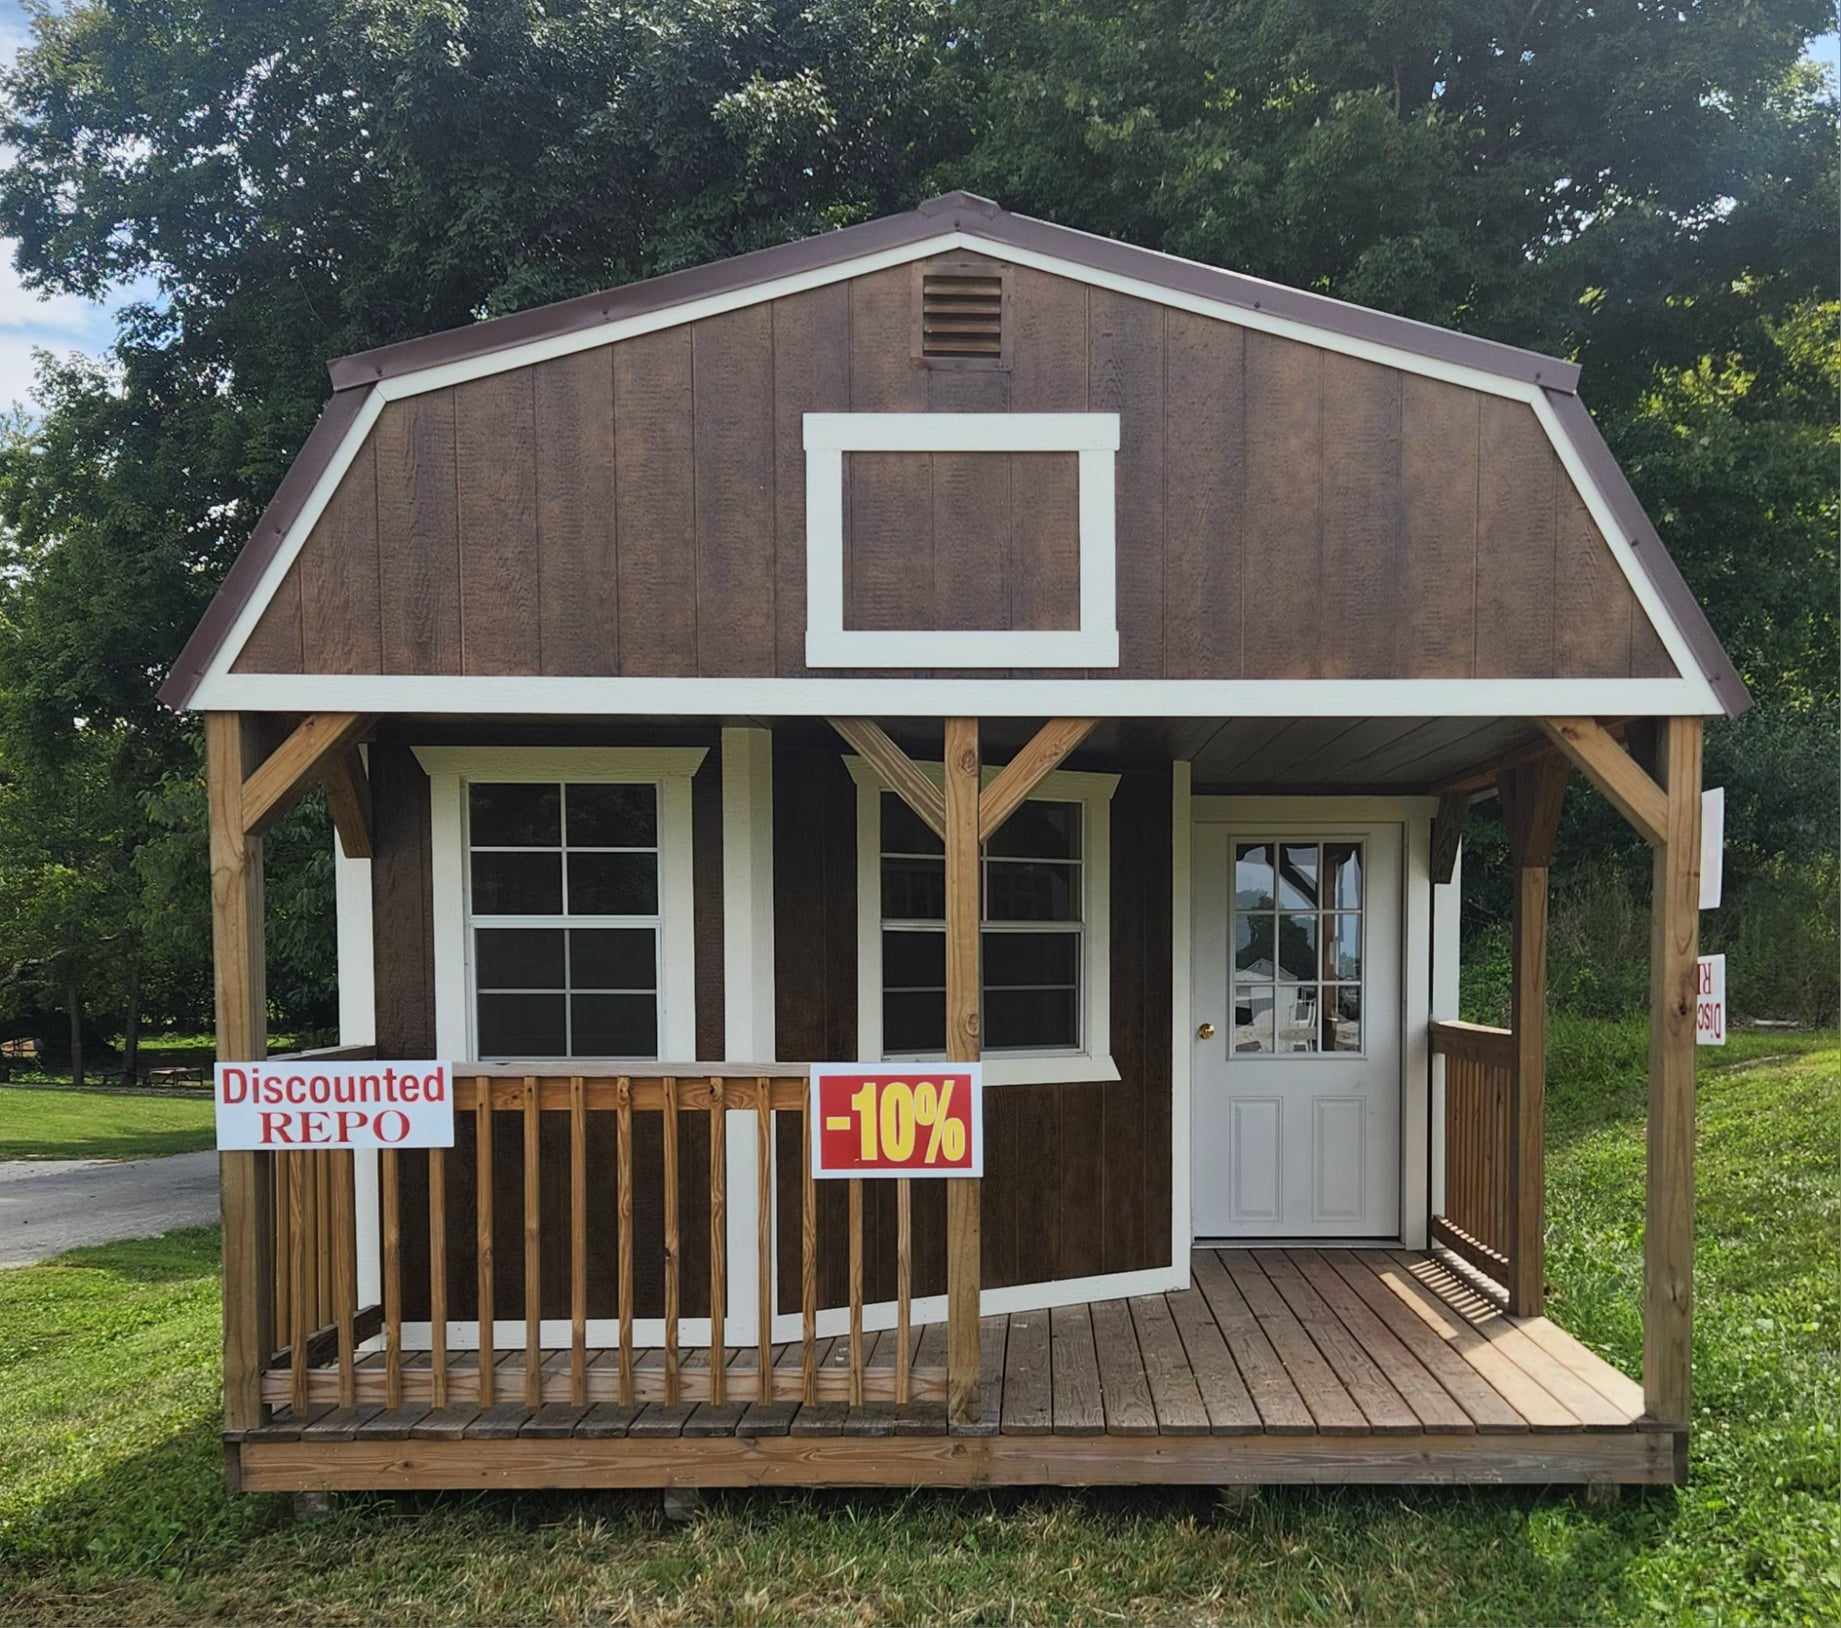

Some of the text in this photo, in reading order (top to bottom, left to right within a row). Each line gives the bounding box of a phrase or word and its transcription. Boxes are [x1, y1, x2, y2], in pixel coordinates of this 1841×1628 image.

[222, 1067, 445, 1104] Discounted
[258, 1110, 411, 1144] REPO
[826, 1080, 966, 1163] -10%
